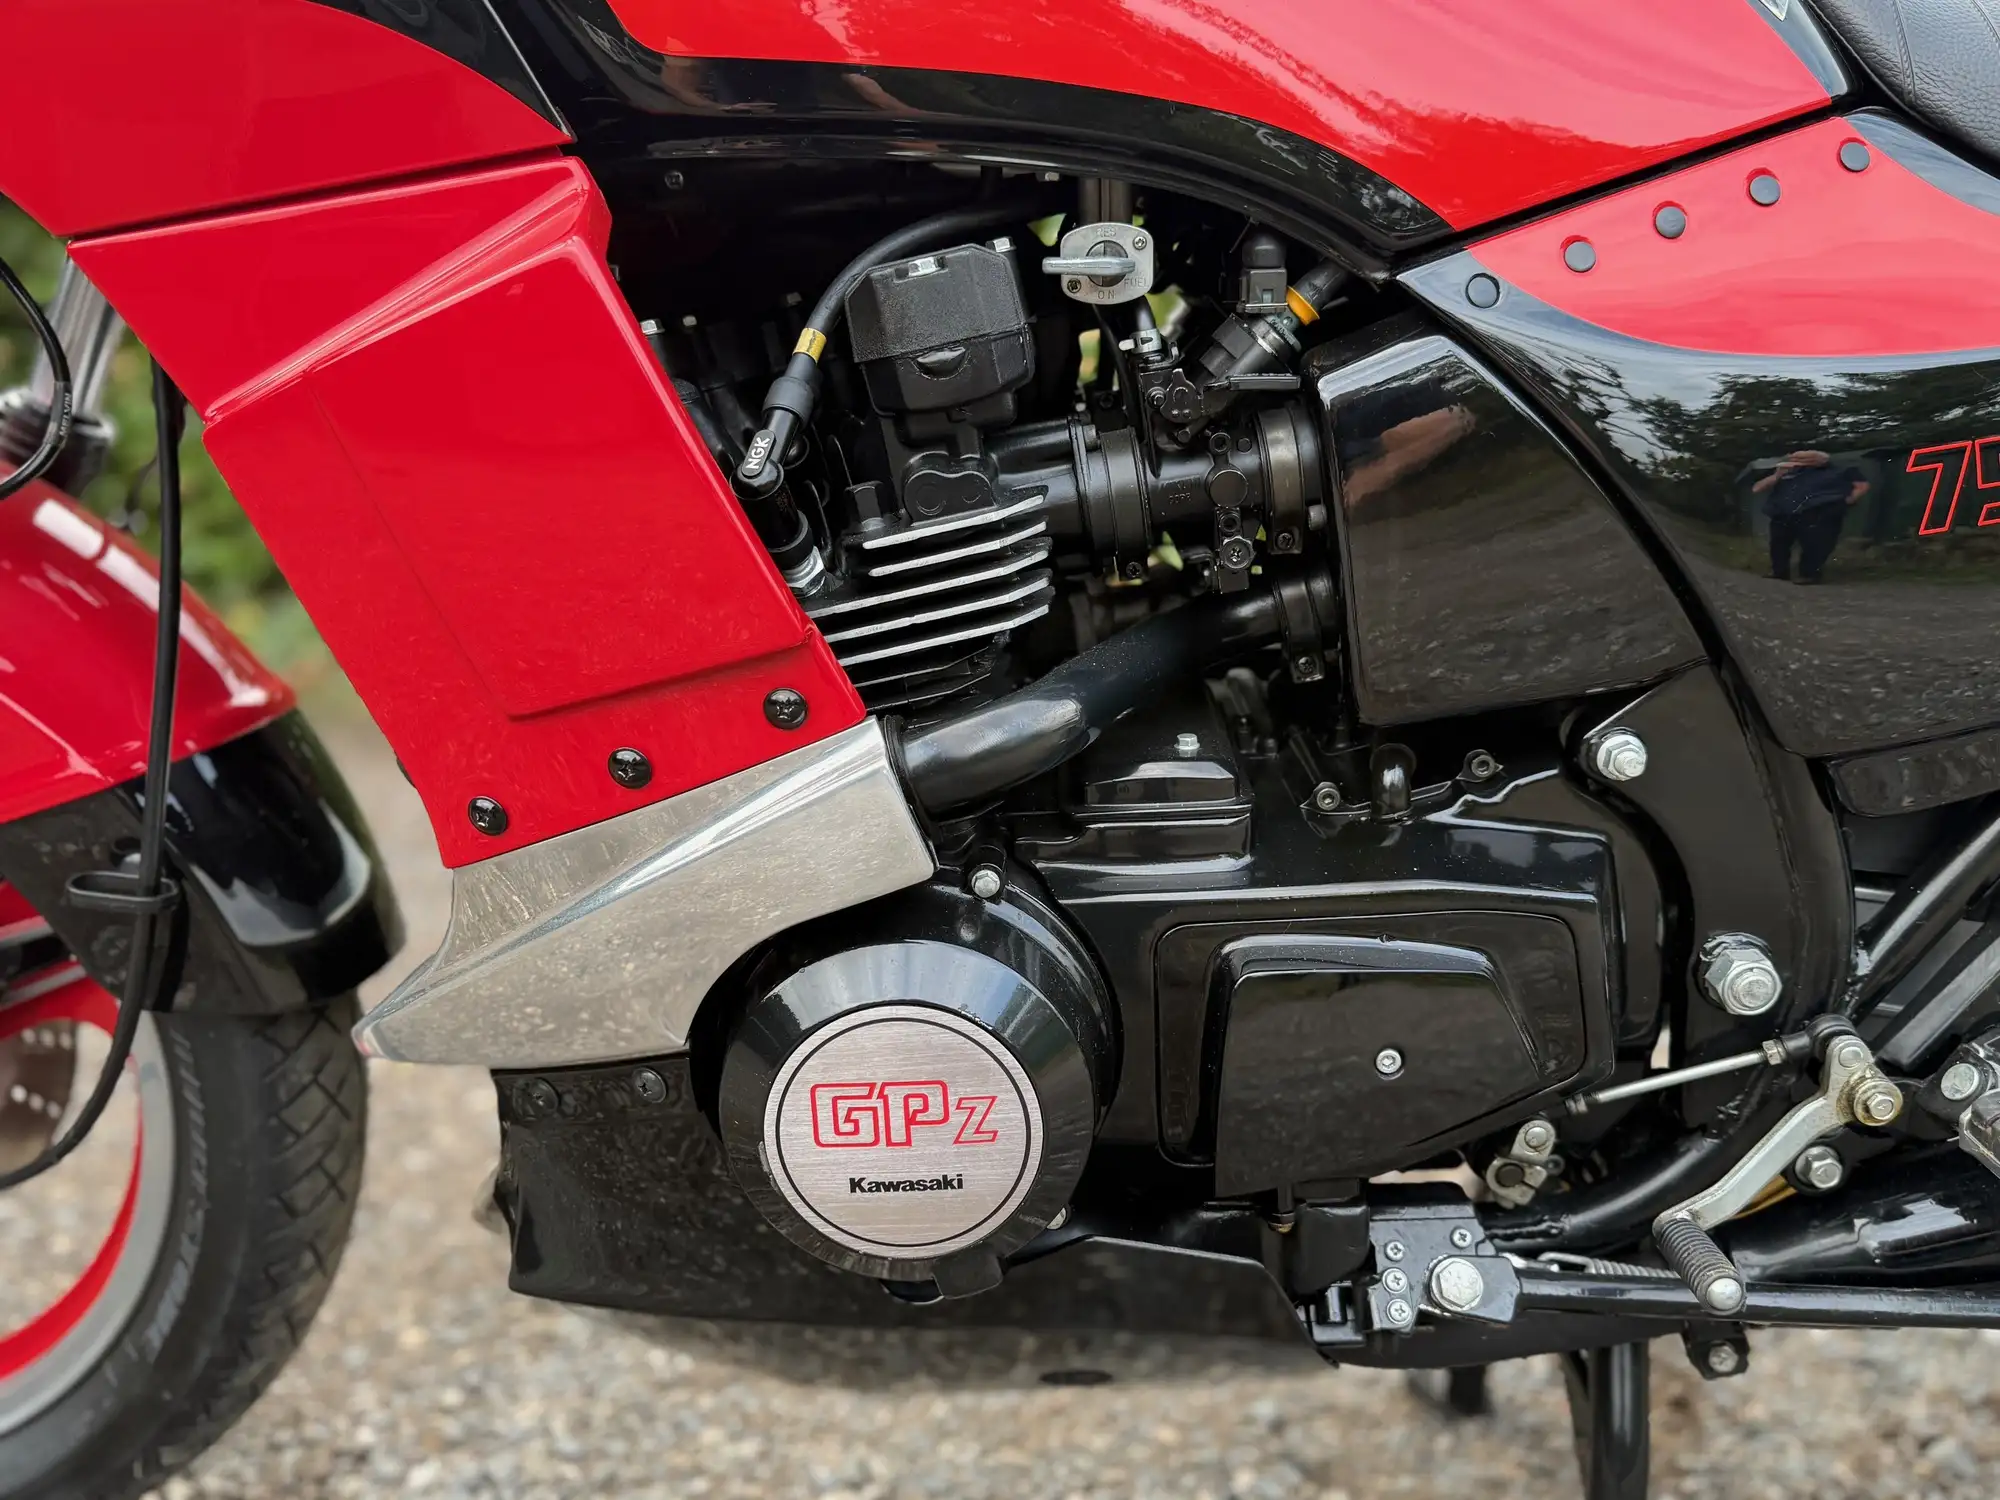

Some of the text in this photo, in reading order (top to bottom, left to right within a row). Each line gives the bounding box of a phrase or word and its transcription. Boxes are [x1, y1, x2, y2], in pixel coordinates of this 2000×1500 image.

[1124, 277, 1149, 289] FUEL
[1097, 289, 1116, 300] ON
[745, 437, 771, 470] NGK
[849, 1174, 963, 1193] Kawasaki
